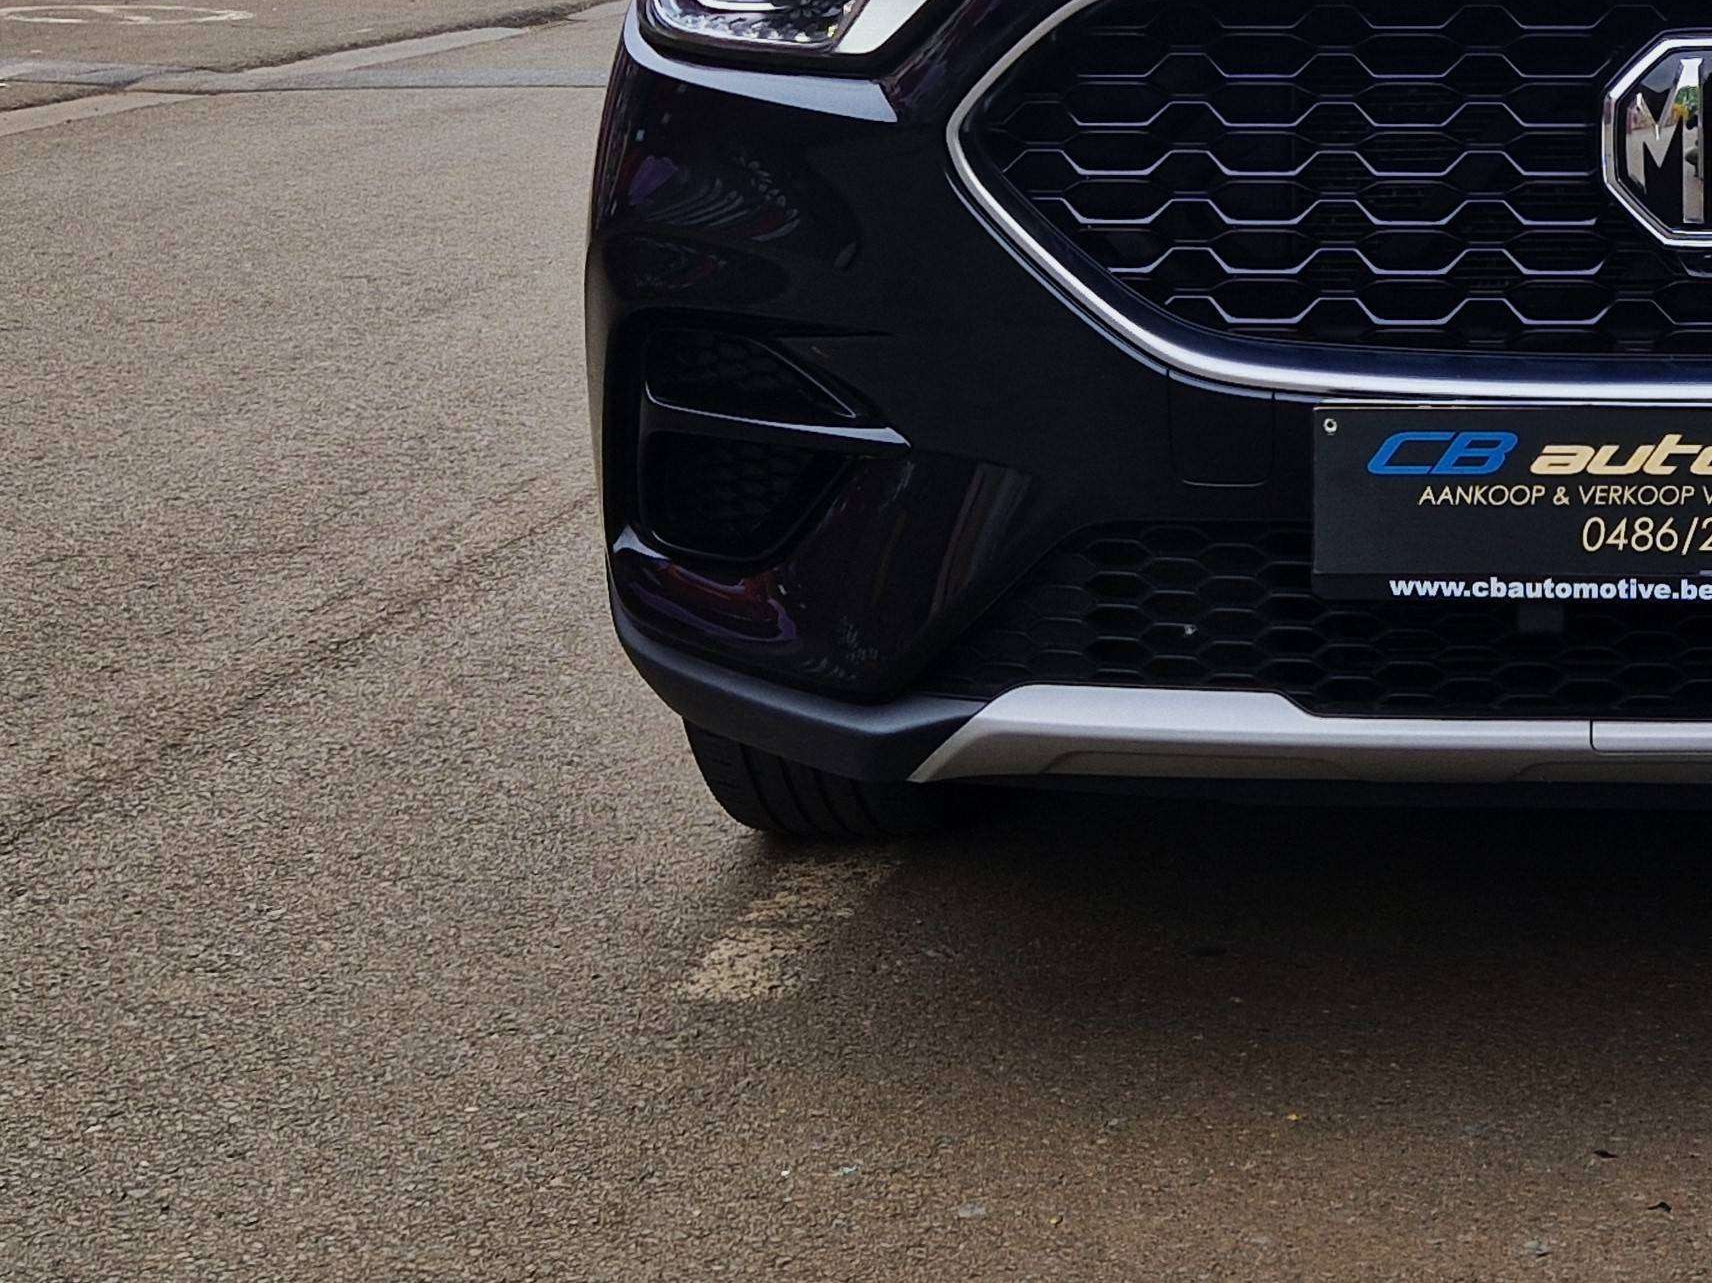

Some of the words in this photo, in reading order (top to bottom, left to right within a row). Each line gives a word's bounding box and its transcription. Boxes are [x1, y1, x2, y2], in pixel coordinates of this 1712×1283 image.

[1367, 431, 1517, 475] CB
[1418, 485, 1546, 506] AANKOOP
[1553, 486, 1570, 506] &
[1578, 485, 1695, 507] VERKOOP
